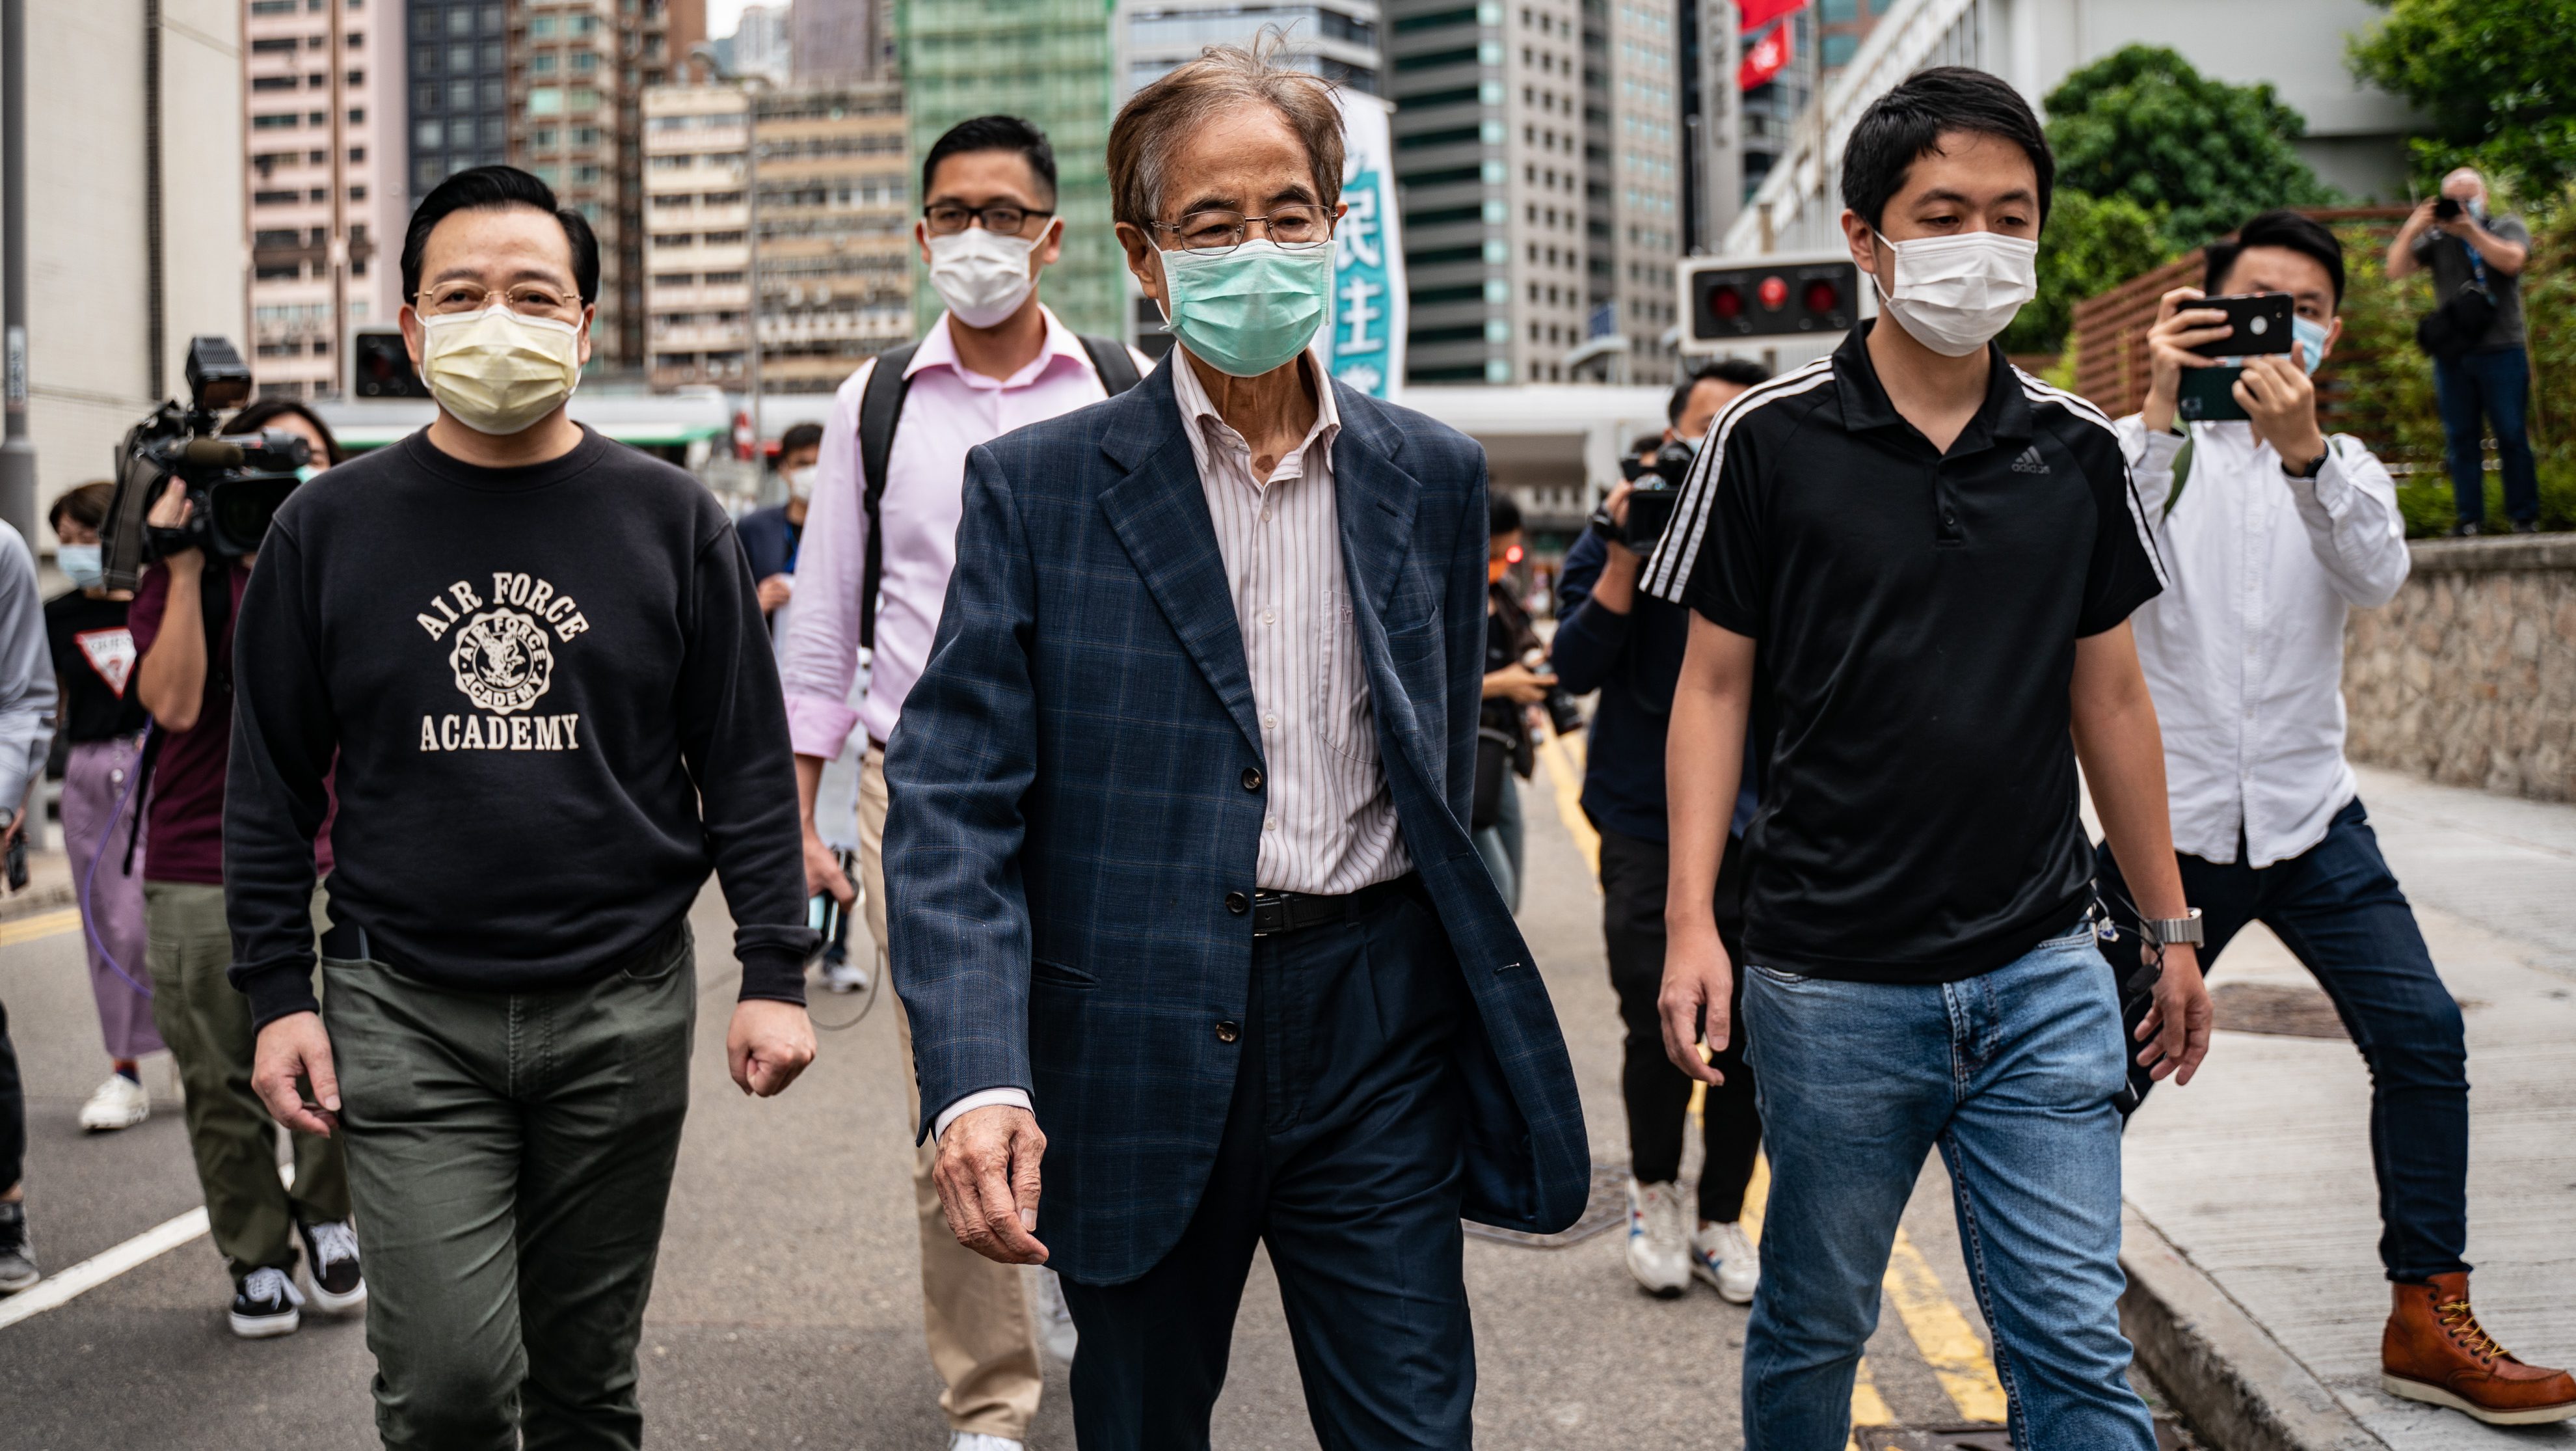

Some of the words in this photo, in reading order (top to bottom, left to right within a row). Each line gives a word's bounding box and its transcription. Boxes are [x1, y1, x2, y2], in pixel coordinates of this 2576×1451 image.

[2011, 463, 2050, 474] adidas
[416, 580, 483, 642] AIR
[492, 572, 590, 643] FORCE
[459, 623, 489, 661] AIR
[493, 618, 546, 662] FORCE
[461, 671, 544, 706] ACADEMY
[420, 714, 579, 752] ACADEMY
